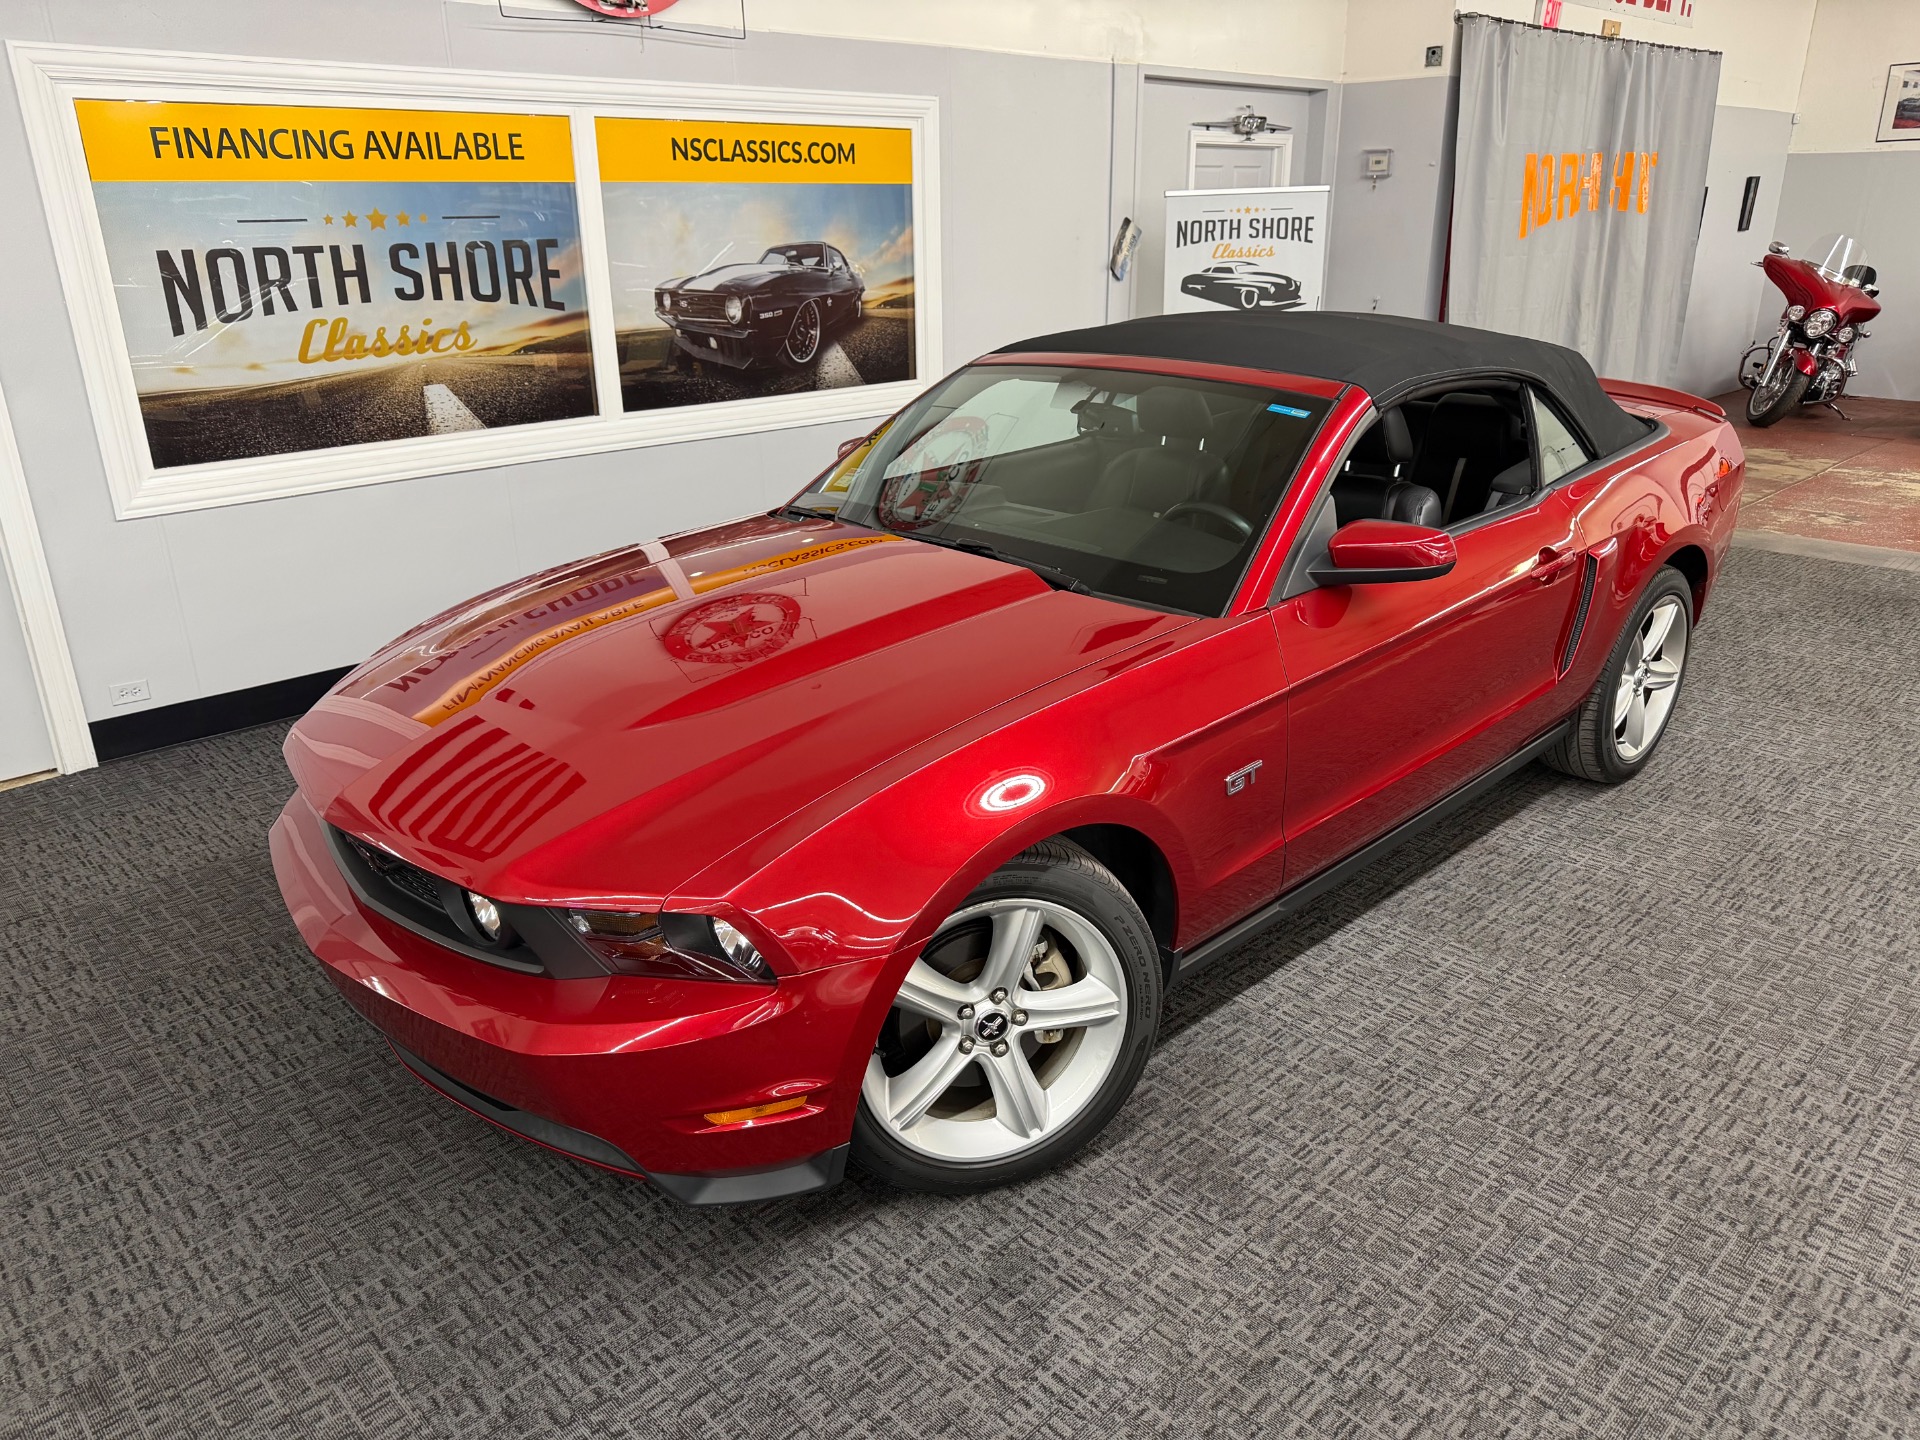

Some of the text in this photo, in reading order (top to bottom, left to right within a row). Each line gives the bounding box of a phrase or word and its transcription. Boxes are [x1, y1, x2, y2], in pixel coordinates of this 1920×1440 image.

[149, 126, 525, 161] FINANCING AVAILABLE
[671, 137, 856, 165] NSCLASSICS.COM
[1176, 216, 1315, 248] NORTH SHORE
[1211, 243, 1276, 259] Classics
[155, 238, 566, 338] NORTH SHORE
[297, 316, 478, 365] Classics
[1224, 759, 1263, 796] GT
[1114, 915, 1126, 925] P
[1122, 925, 1147, 968] ZERO
[1142, 971, 1152, 1019] NERO
